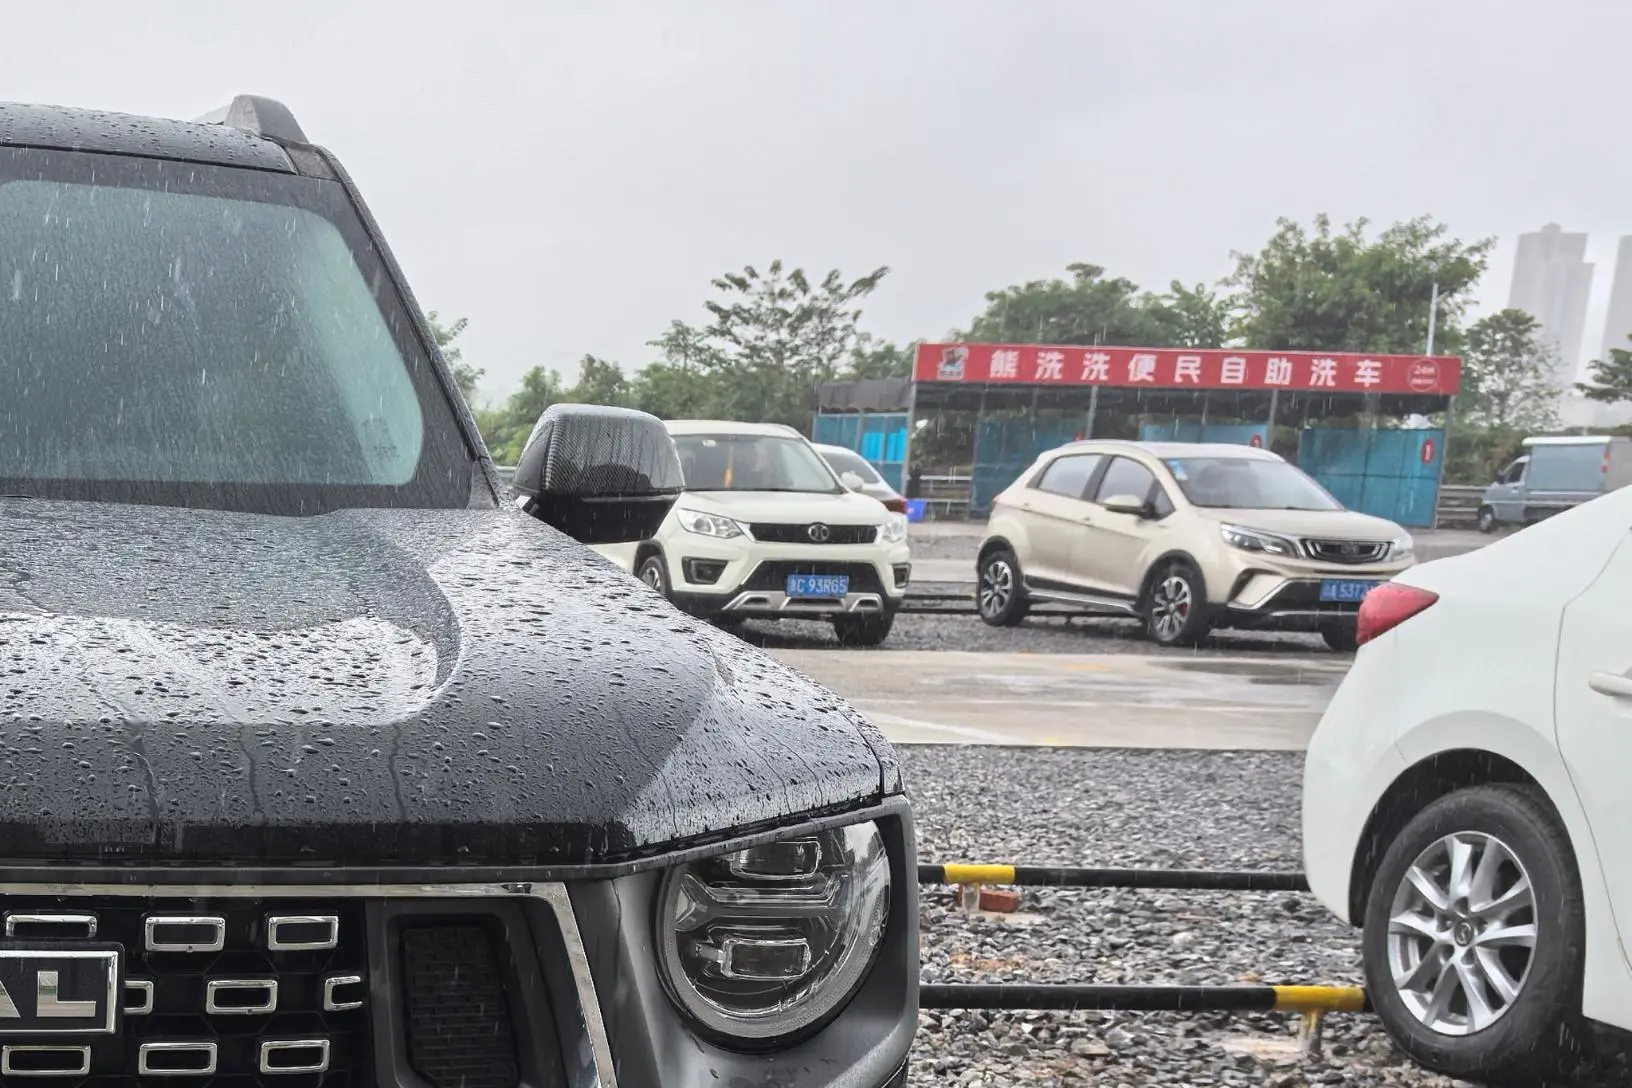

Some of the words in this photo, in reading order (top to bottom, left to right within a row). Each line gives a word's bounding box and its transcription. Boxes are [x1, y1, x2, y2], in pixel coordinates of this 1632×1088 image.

[990, 349, 1382, 387] 熊洗洗便民自助洗车
